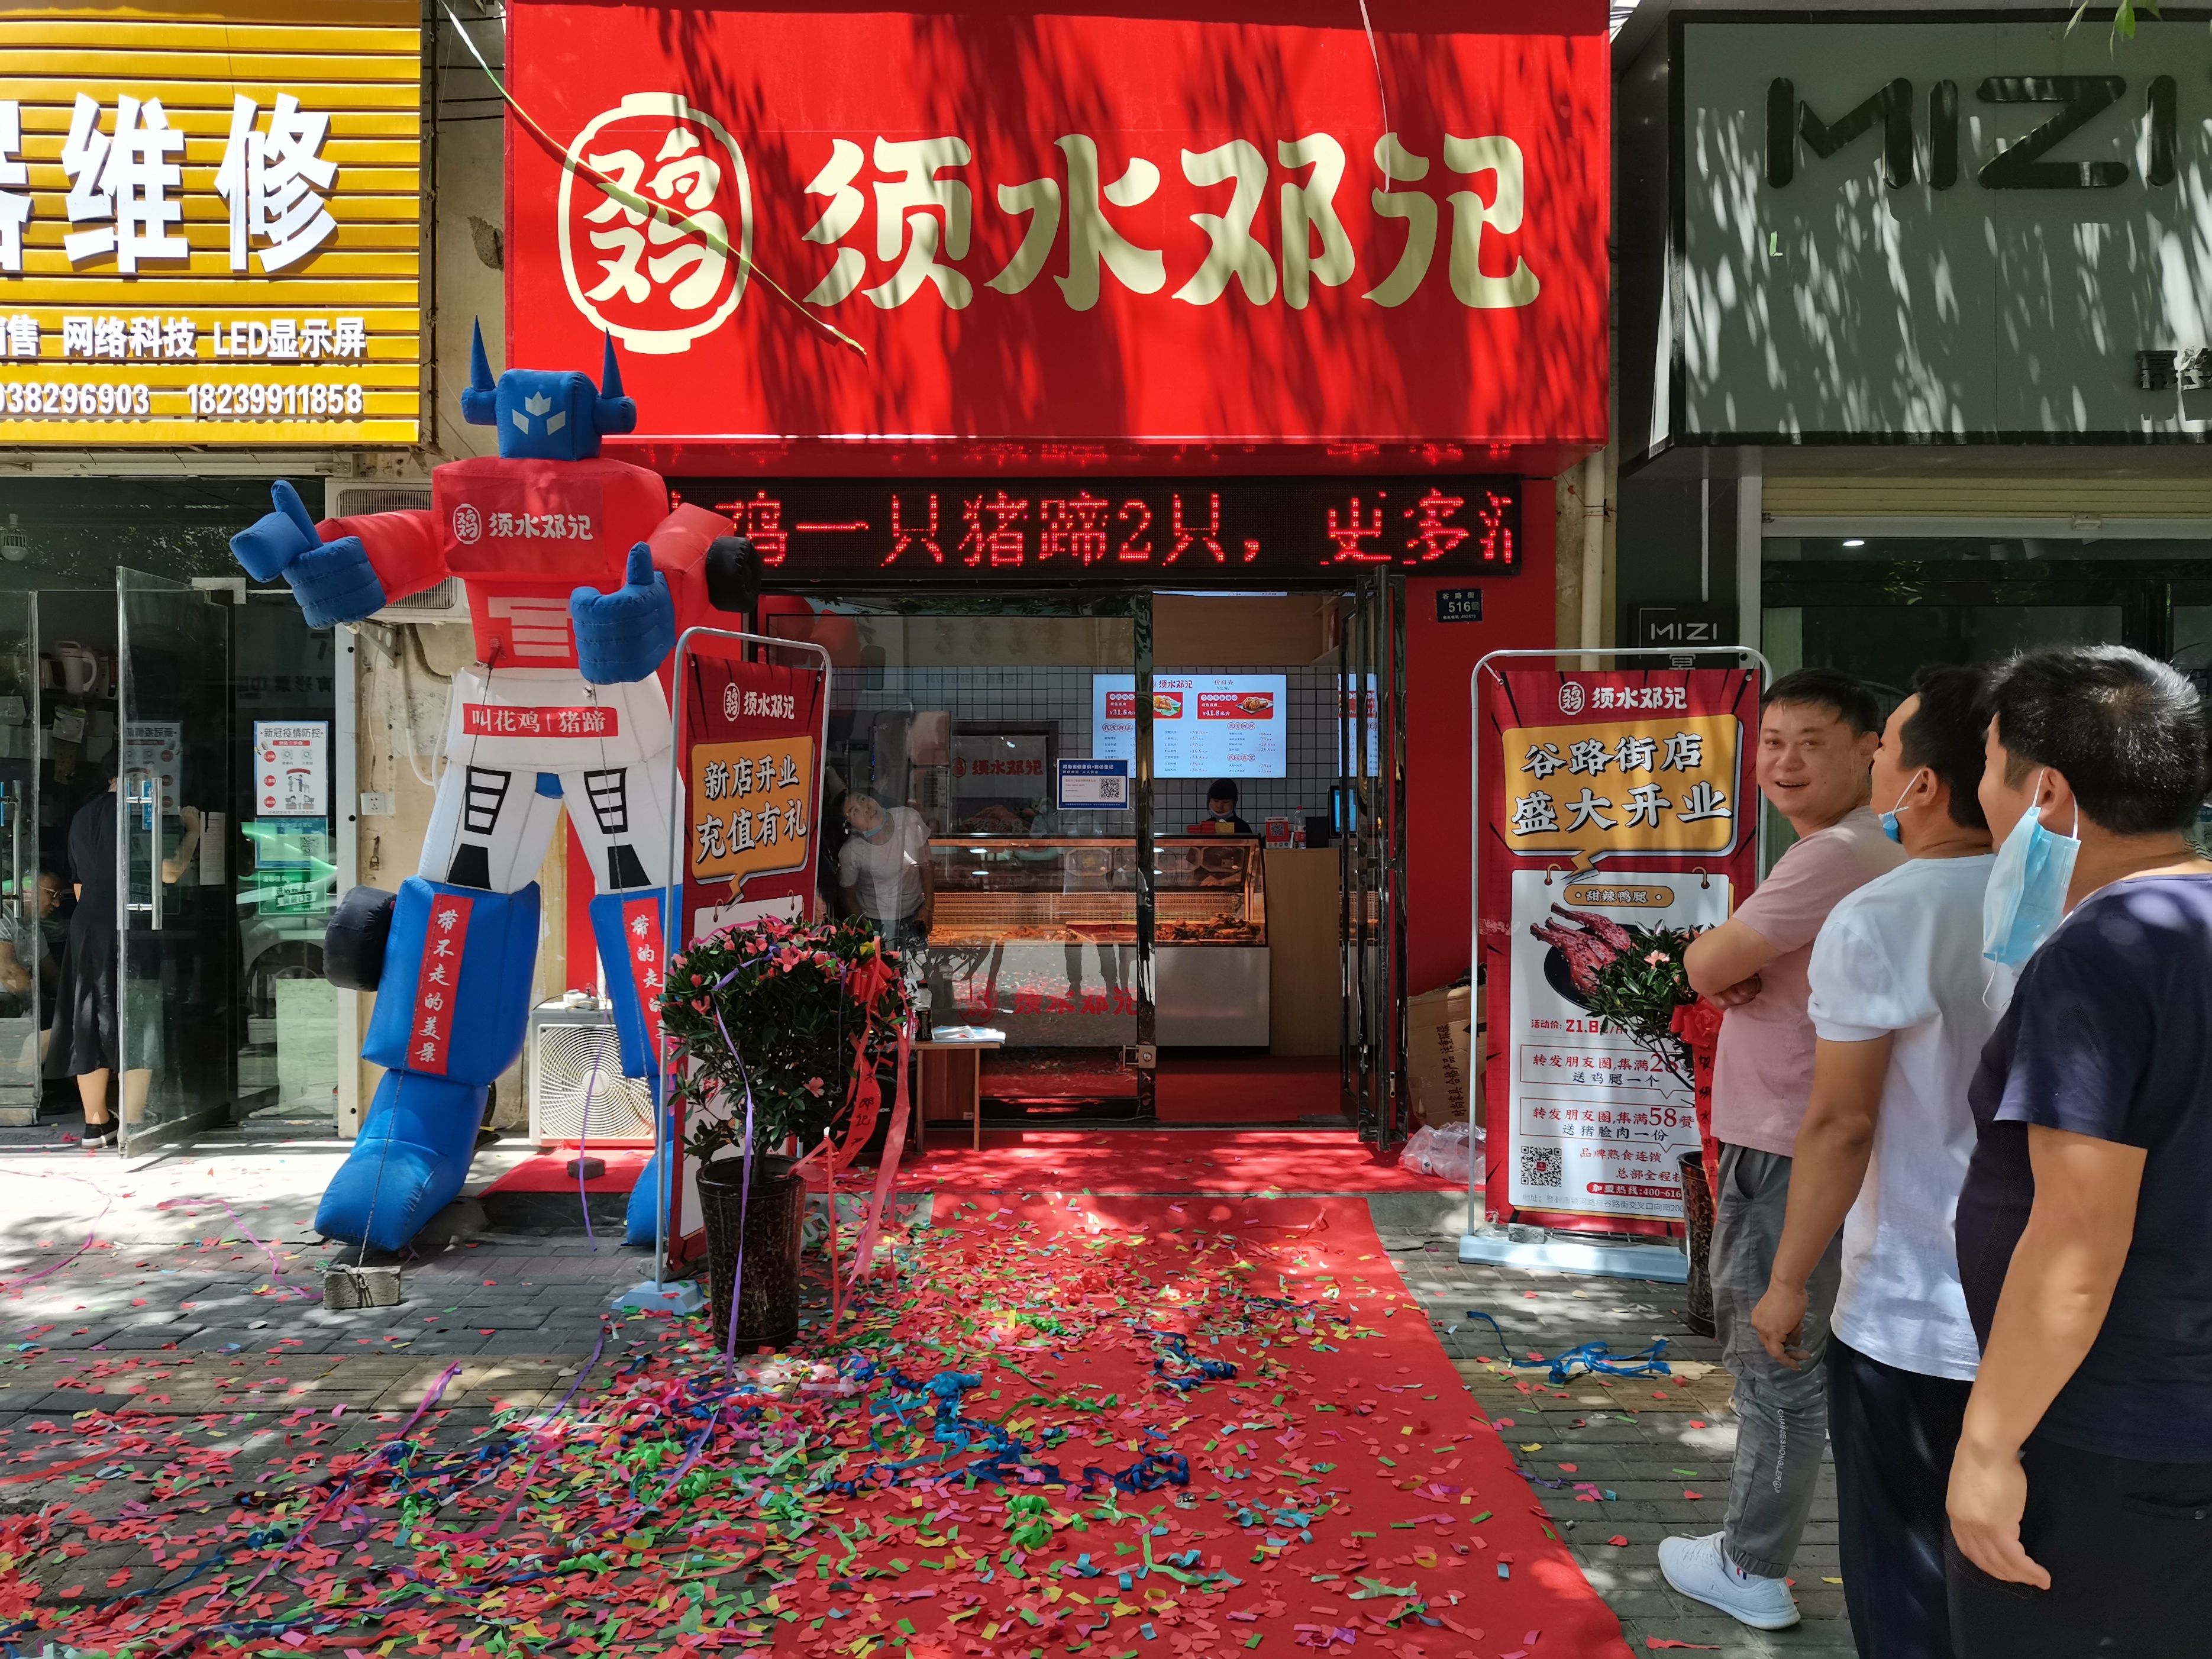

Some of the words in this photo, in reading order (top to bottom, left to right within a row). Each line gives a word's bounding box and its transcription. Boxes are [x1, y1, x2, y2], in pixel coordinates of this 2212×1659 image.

[1766, 75, 2177, 189] MIZI
[0, 92, 338, 273] 维修
[583, 127, 728, 310] 鸡
[802, 133, 1539, 311] 须水邓记
[0, 314, 40, 356] 售
[63, 315, 197, 357] 网络科技
[214, 317, 366, 357] LED显示屏
[187, 383, 363, 415] 18239911858
[489, 512, 593, 540] 须水邓记
[1448, 601, 1471, 613] 516
[1651, 623, 1717, 640] MIZI
[1158, 680, 1193, 689] 须水邓记
[1591, 687, 1687, 709] 须水邓记
[743, 691, 795, 720] 须水邓记
[264, 728, 321, 738] 新冠疫情防控
[472, 709, 540, 732] 叫花鸡
[558, 709, 606, 733] 猪蹄
[1520, 732, 1702, 780] 谷路街店
[703, 754, 800, 800] 新店开业
[1512, 781, 1734, 837] 盛大开业
[696, 799, 808, 865] 充值有礼
[1585, 889, 1648, 903] 甜辣鸭腿
[415, 909, 458, 1063] 带不走的美景
[1531, 1019, 1562, 1029] 活动价:
[1442, 1056, 1461, 1086] 合格产品
[1572, 1071, 1660, 1087] 送鸡腿一个
[1448, 1087, 1467, 1117] 时尚家具
[1562, 1124, 1670, 1142] 送猪脸肉一份
[1580, 1148, 1662, 1163] 品牌熟食连锁
